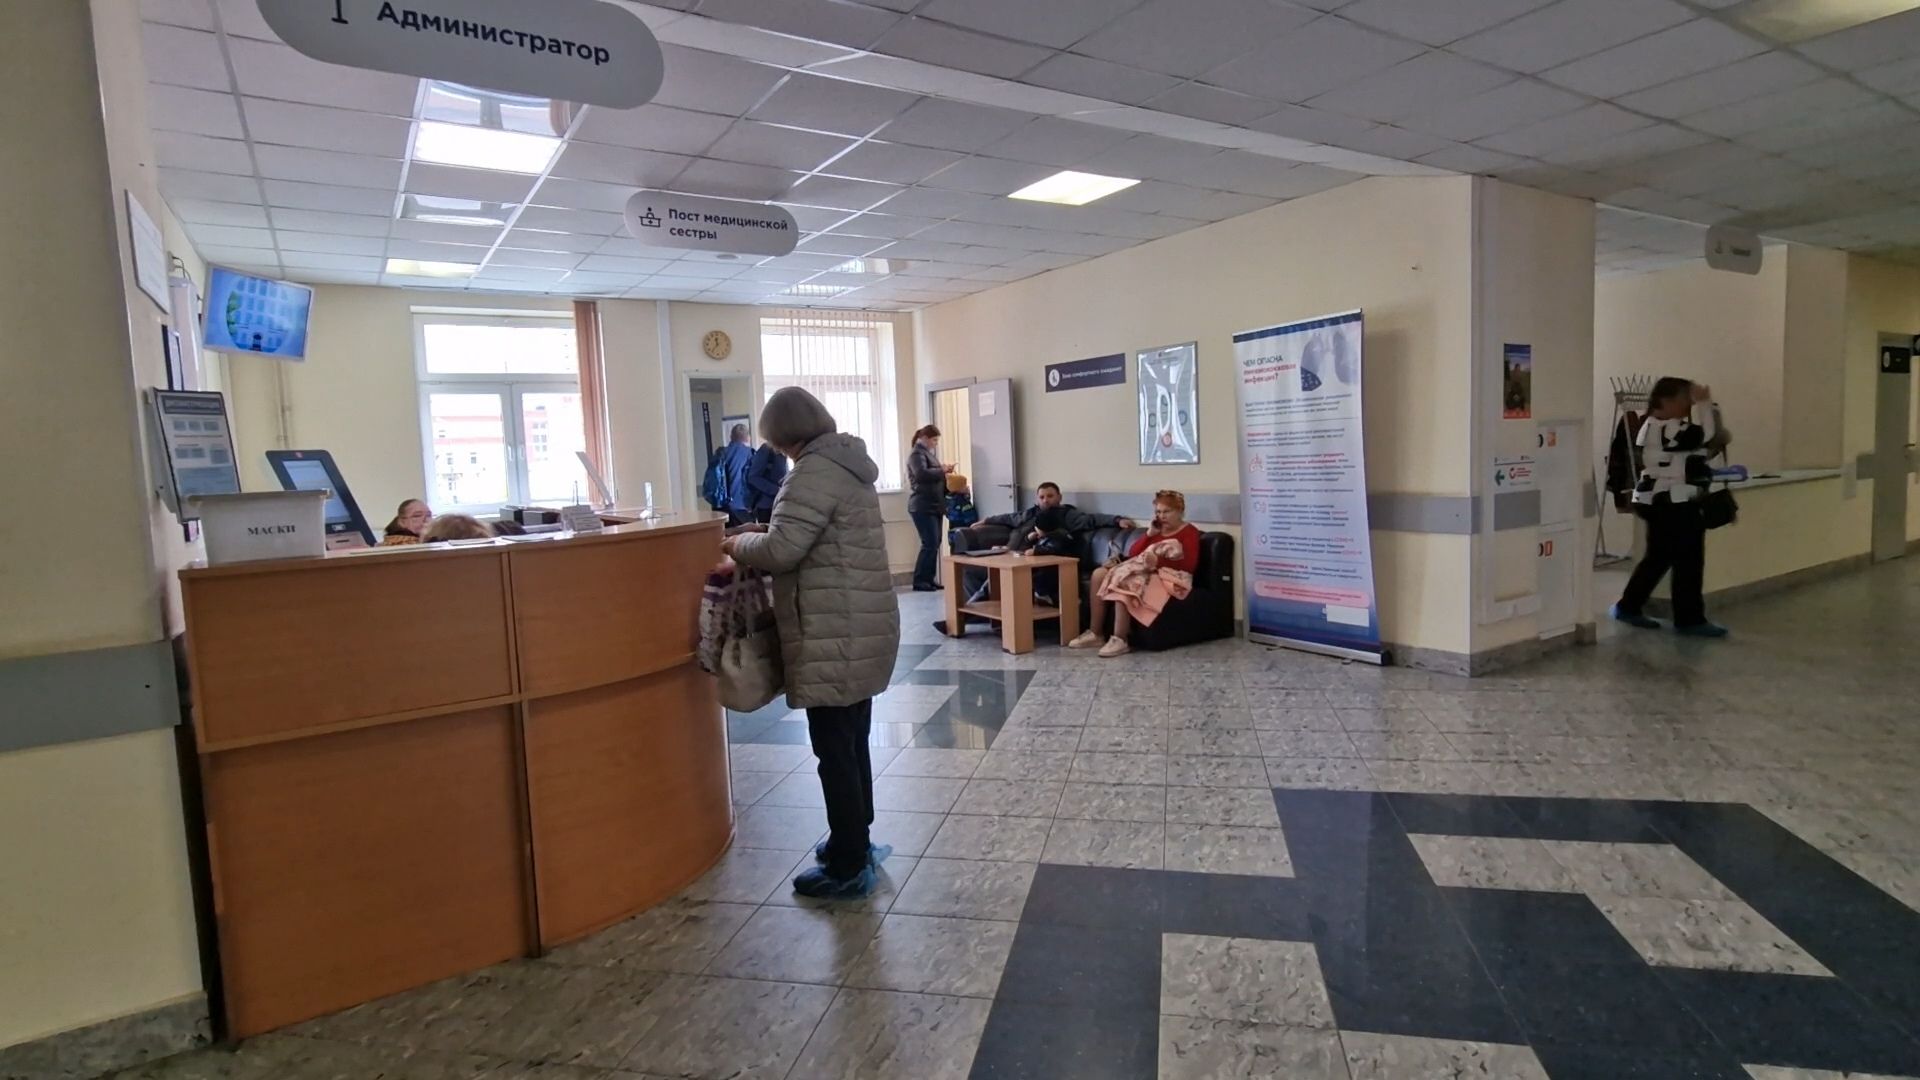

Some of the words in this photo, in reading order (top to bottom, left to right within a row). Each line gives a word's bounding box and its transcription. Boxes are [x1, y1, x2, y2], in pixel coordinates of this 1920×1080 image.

[377, 2, 610, 65] Администратор
[668, 208, 701, 221] Пост
[703, 214, 789, 231] медицинской
[669, 226, 718, 240] сестры
[247, 524, 296, 536] МАСКИ
